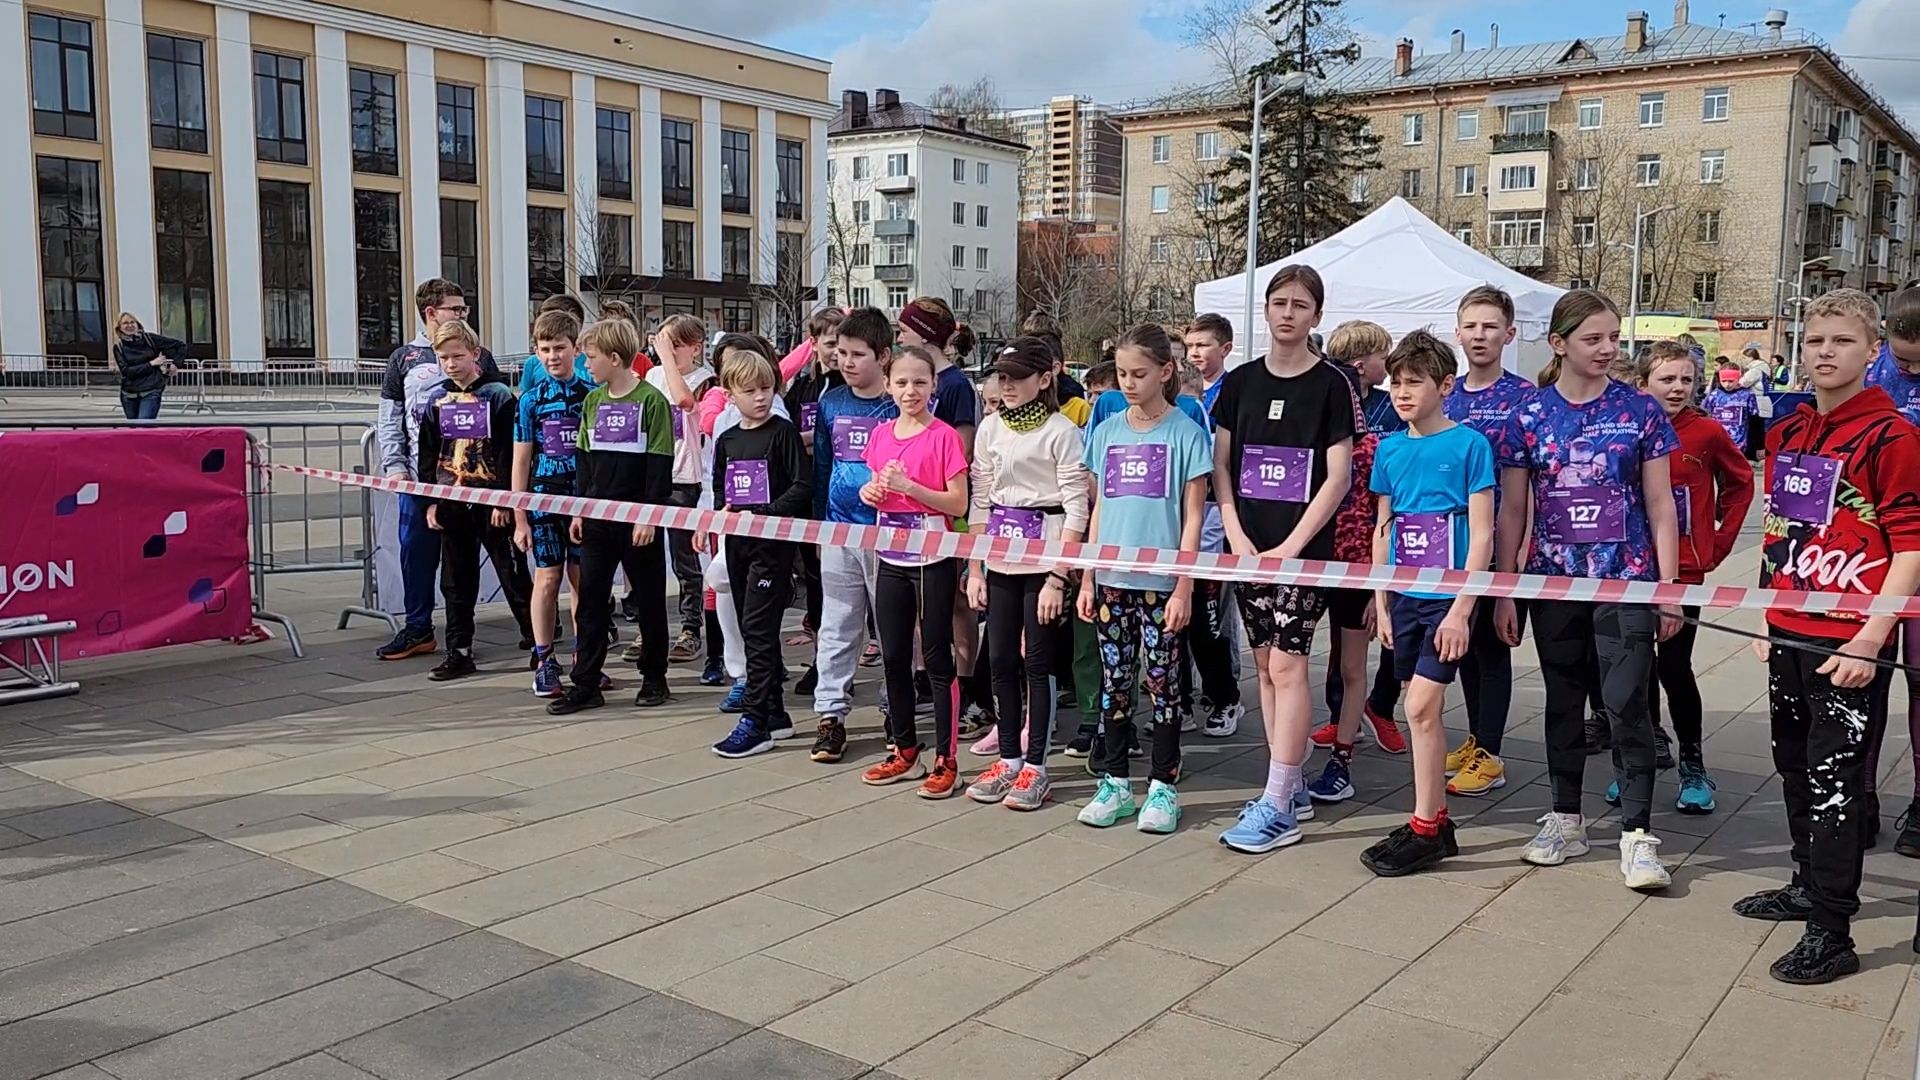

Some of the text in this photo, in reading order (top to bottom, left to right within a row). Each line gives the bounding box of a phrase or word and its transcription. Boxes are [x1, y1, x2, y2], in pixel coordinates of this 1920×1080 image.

[1733, 320, 1765, 329] Стриж
[453, 414, 475, 426] 134
[606, 415, 626, 427] 133
[559, 430, 578, 442] 116
[848, 431, 869, 445] 131
[1583, 430, 1600, 438] HALF
[1119, 460, 1148, 477] 156
[1259, 463, 1286, 481] 118
[733, 475, 752, 488] 119
[1783, 474, 1812, 496] 168
[1566, 505, 1602, 521] 127
[999, 523, 1024, 539] 136
[1401, 531, 1430, 548] 154
[1782, 539, 1888, 595] LOOK
